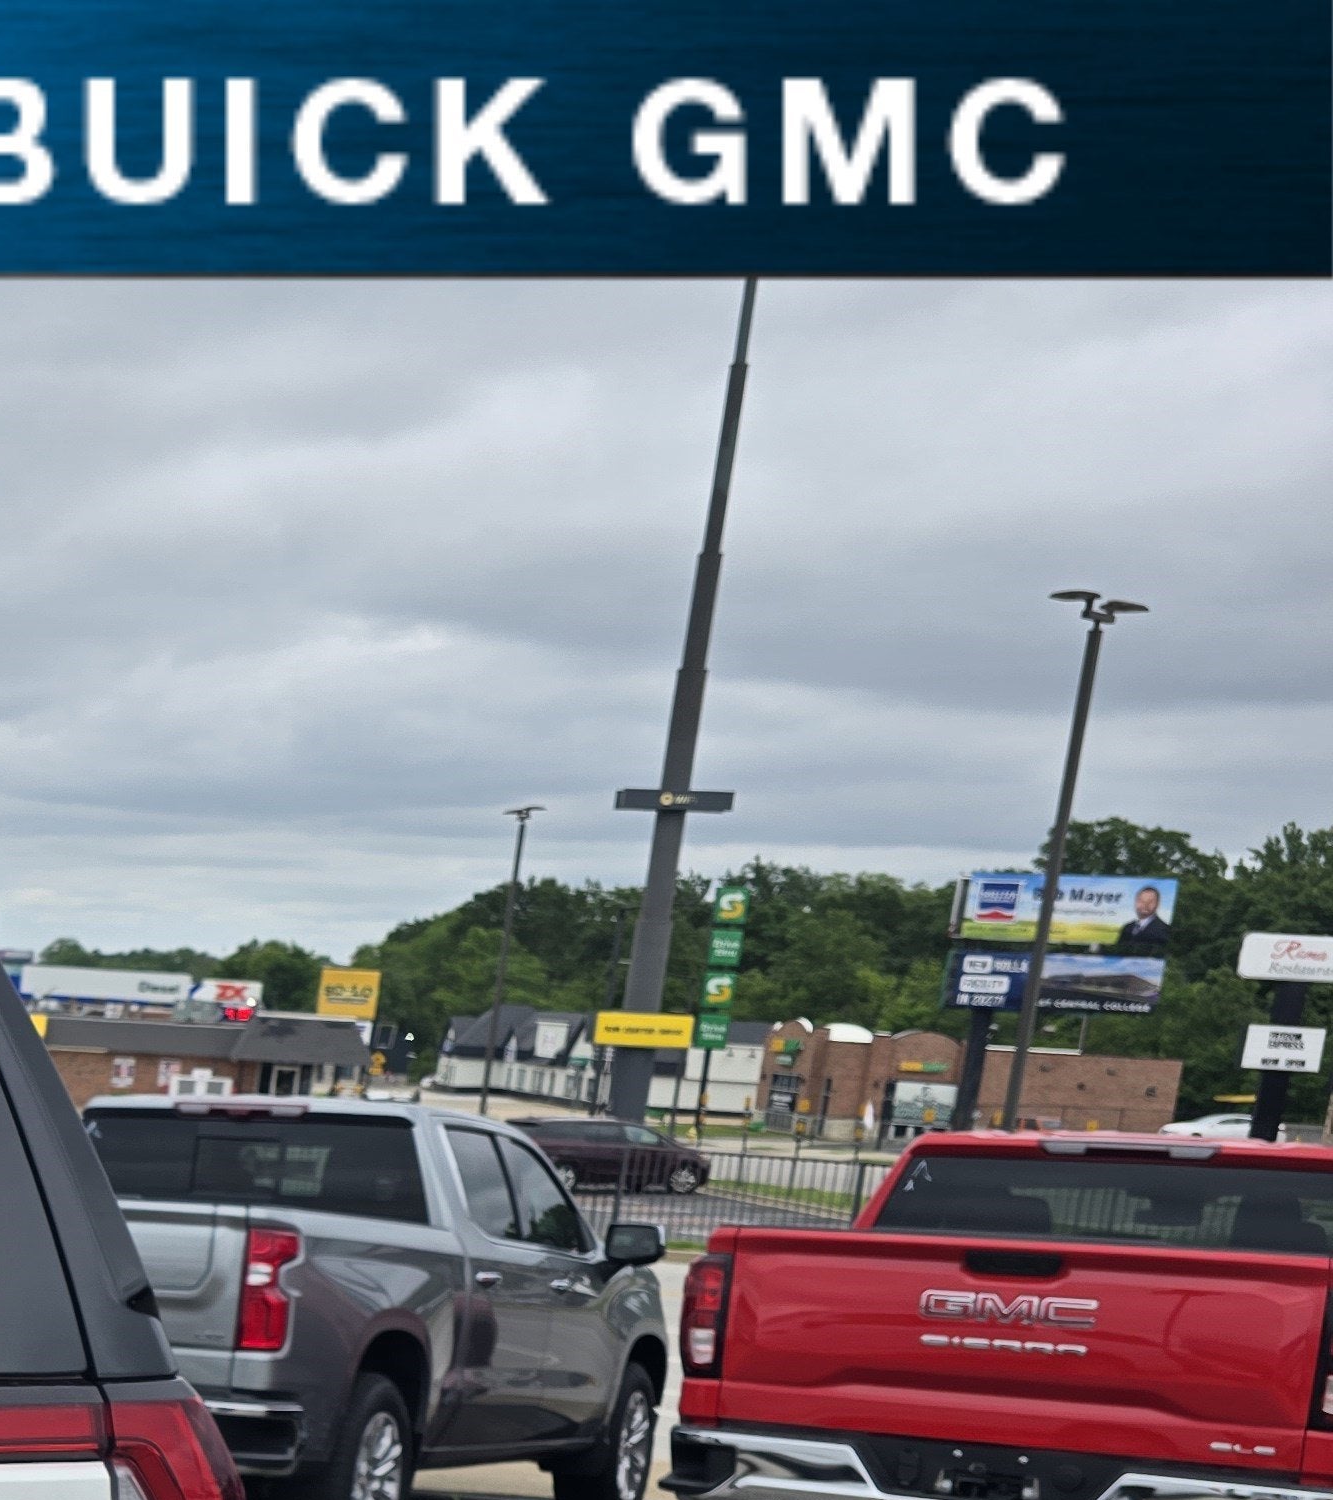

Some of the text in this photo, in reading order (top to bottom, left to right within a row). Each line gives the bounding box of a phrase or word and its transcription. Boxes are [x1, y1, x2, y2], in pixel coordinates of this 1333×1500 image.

[1069, 887, 1123, 906] Mayer
[1102, 1000, 1151, 1014] COLLEGE
[919, 1288, 1100, 1329] GMC
[919, 1333, 1088, 1356] SIERRA
